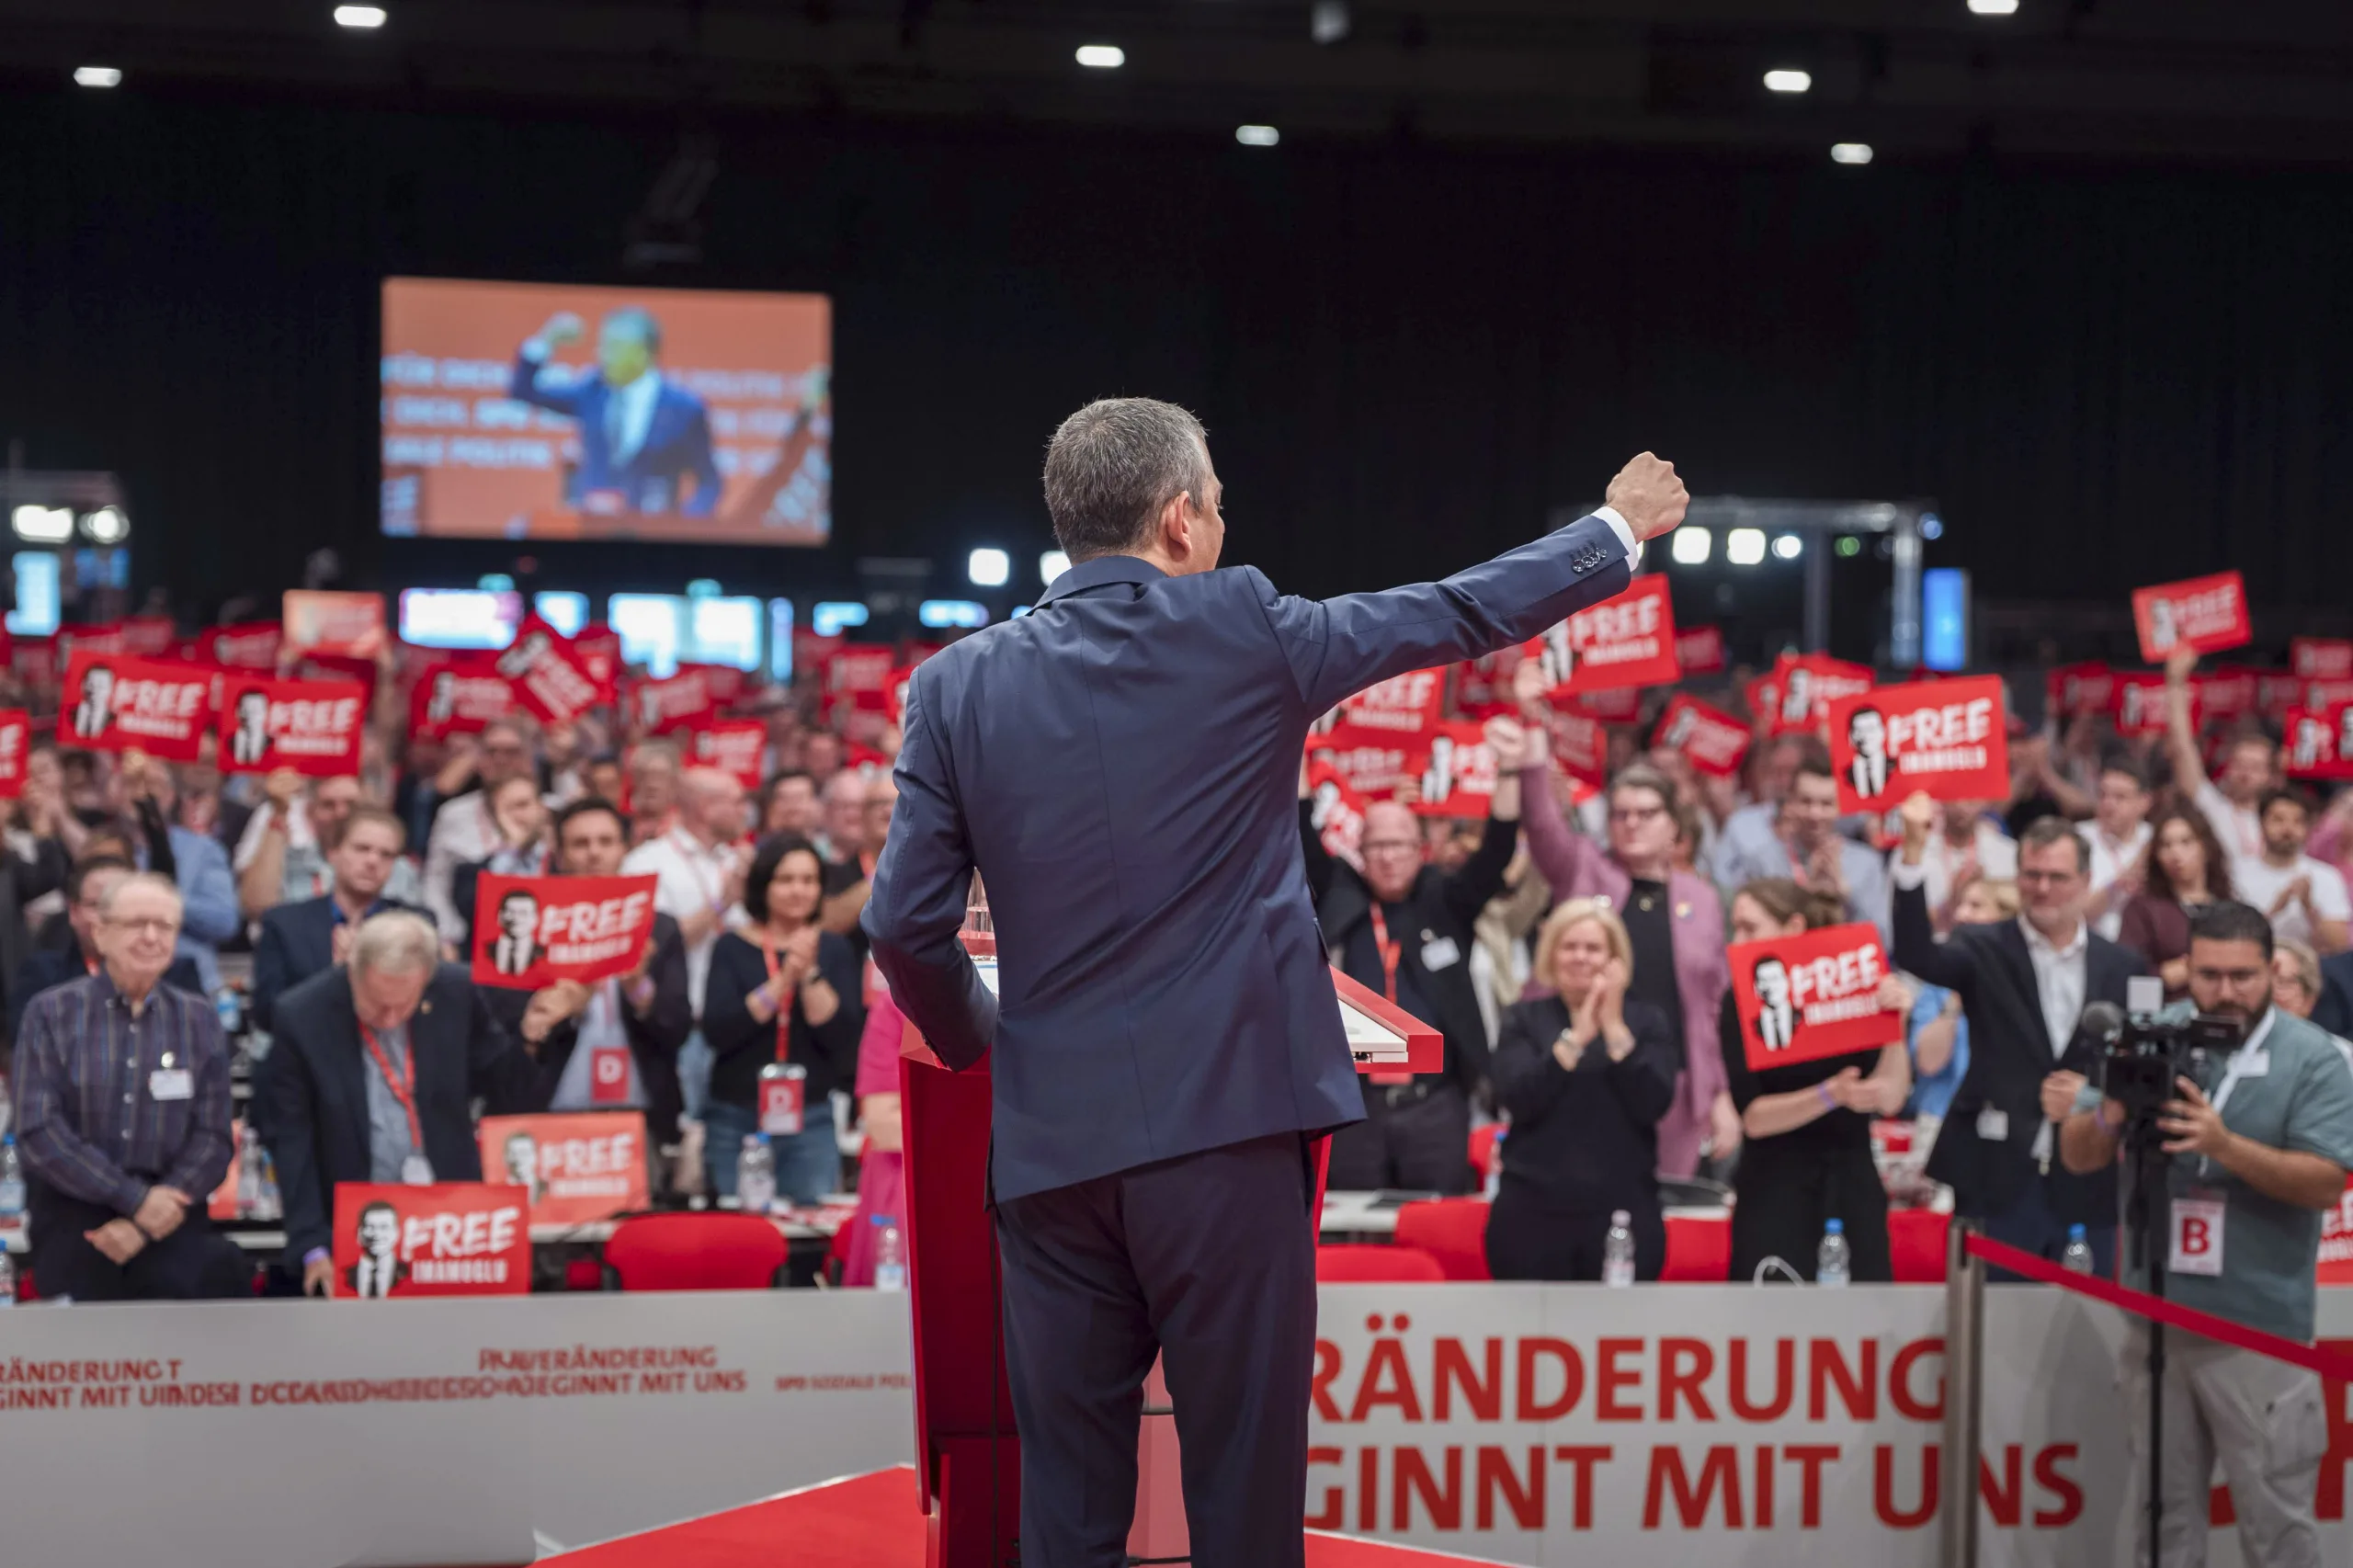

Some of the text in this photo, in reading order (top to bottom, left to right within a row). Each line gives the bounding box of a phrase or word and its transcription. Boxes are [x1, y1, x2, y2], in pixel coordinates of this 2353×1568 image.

[1570, 593, 1662, 653] FREE
[113, 677, 206, 717] FREE
[267, 697, 359, 734] FREE
[1342, 672, 1437, 711] REE
[1885, 696, 1994, 759] FREE
[538, 889, 651, 947] FREE
[1789, 942, 1881, 1010] FREE
[597, 1054, 623, 1085] D
[538, 1131, 636, 1182] FREE
[401, 1205, 521, 1264] FREE
[2181, 1217, 2211, 1256] B
[694, 1368, 747, 1393] UNS
[1312, 1313, 1947, 1424] RÄNDERUNG
[81, 1383, 132, 1408] MIT
[1304, 1442, 2086, 1533] GINNT MIT UNS
